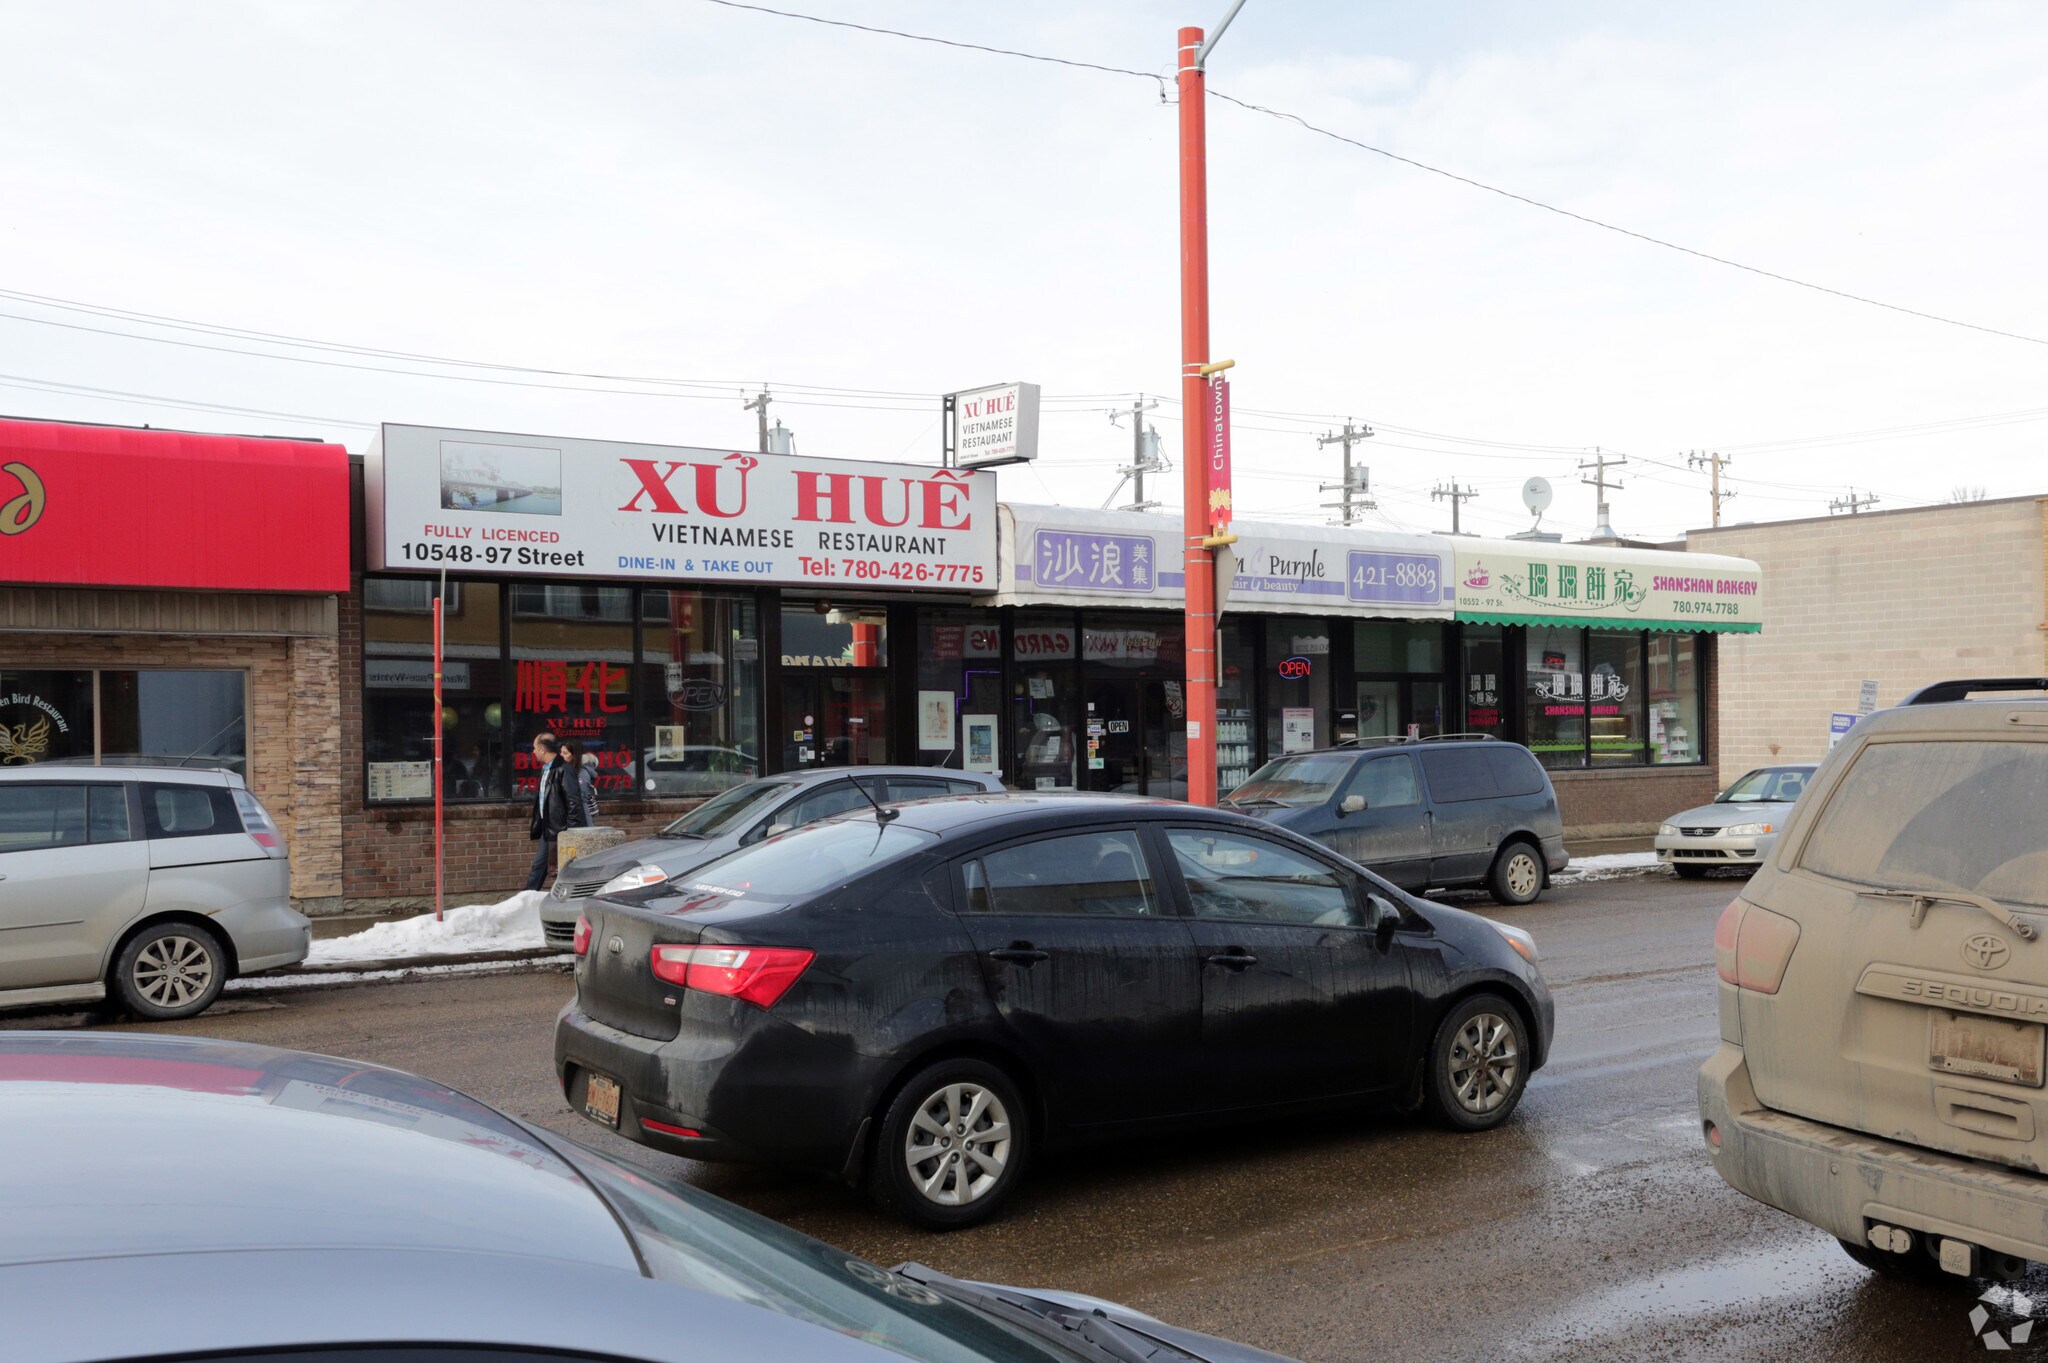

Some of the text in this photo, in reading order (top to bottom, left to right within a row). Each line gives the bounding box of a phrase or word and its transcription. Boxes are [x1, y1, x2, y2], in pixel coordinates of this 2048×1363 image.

[962, 417, 1013, 435] VIETNAMESE
[1213, 380, 1224, 470] Chinatown
[962, 431, 1013, 448] RESTAURANT
[618, 453, 975, 531] XỨ HUẾ
[424, 525, 560, 543] FULLY LICENCED
[652, 523, 946, 555] VIETNAMESE RESTAURANT
[402, 542, 585, 566] 10548-97 Street
[618, 556, 773, 573] DINE-IN & TAKE OUT
[1042, 538, 1123, 586] 沙浪
[1131, 544, 1149, 586] 美集
[798, 556, 984, 583] Tel: 780-426-7775
[1269, 549, 1325, 584] Purple
[1353, 561, 1437, 592] 421-8883
[1231, 577, 1299, 593] air beauty
[1653, 576, 1758, 596] SHANSHAN BAKERY
[1459, 598, 1479, 606] 10552
[1673, 601, 1739, 615] 780.974.7788
[1279, 661, 1311, 676] OPEN
[515, 659, 628, 713] 順化
[12, 693, 31, 704] Bird
[33, 695, 69, 733] Restaurant
[1545, 706, 1584, 715] SHANSHAN
[553, 728, 601, 737] Restaurant
[1110, 721, 1128, 732] OPEN
[1902, 981, 2048, 1015] SEQUOIA
